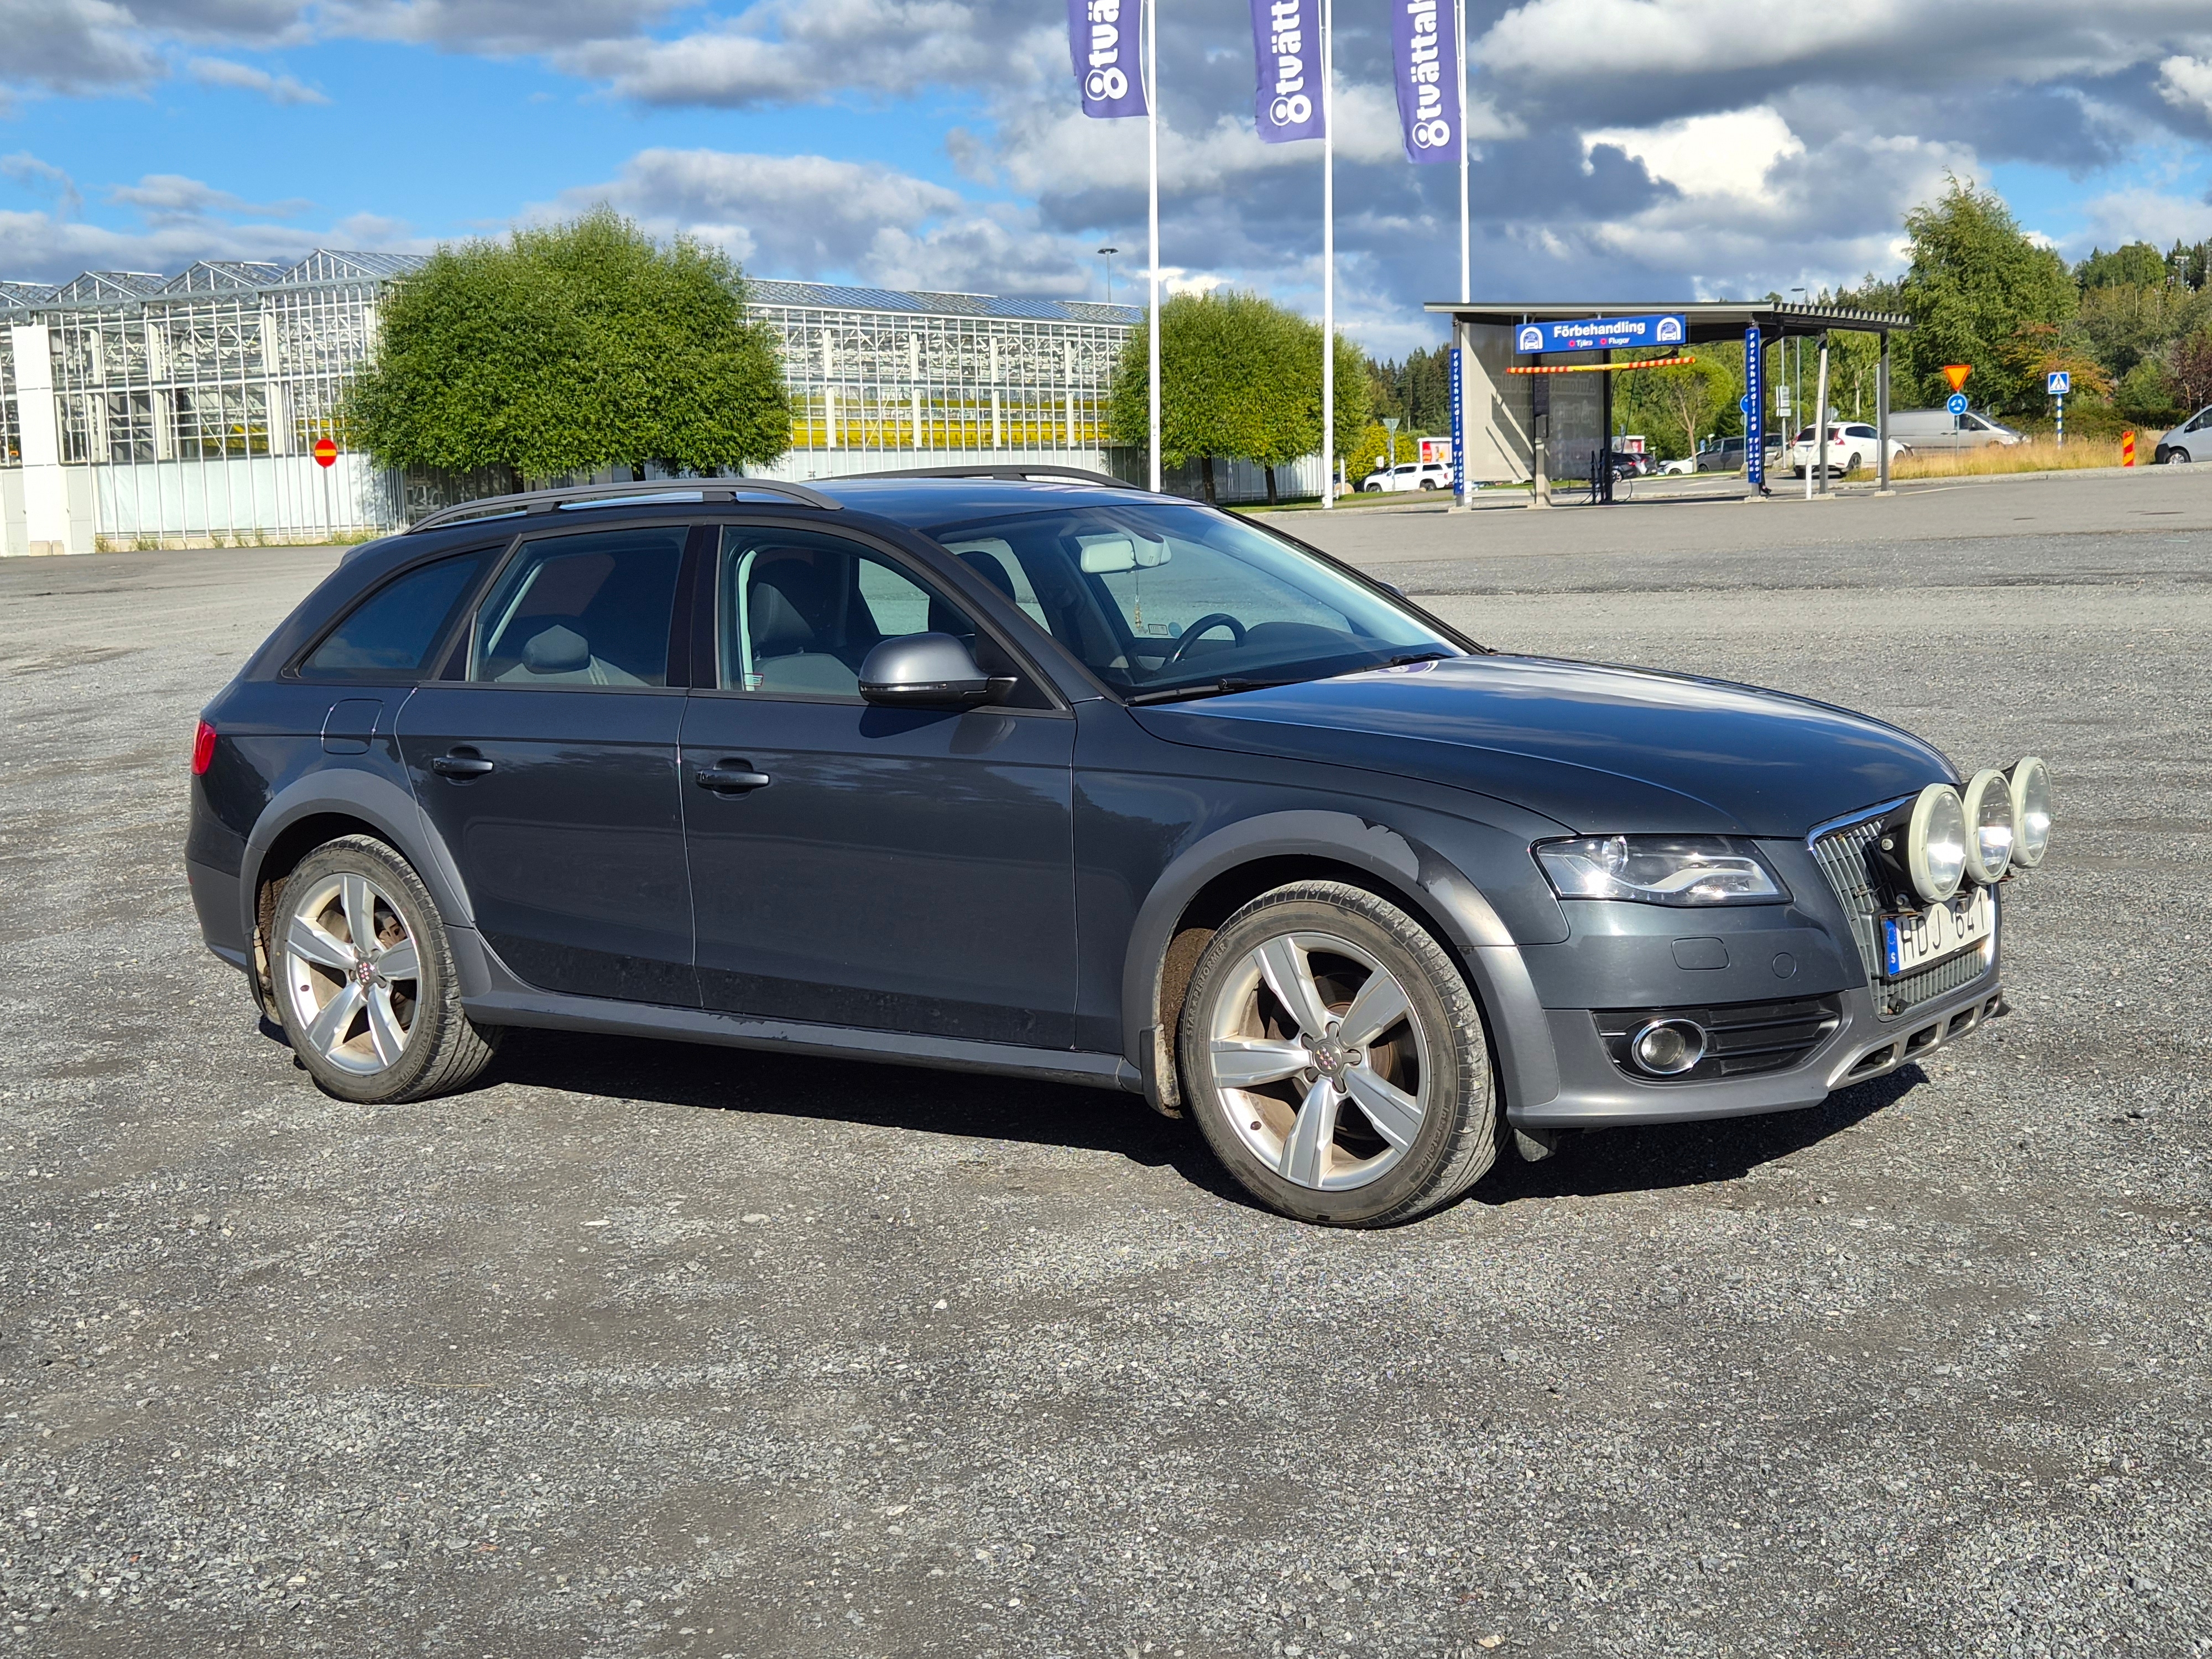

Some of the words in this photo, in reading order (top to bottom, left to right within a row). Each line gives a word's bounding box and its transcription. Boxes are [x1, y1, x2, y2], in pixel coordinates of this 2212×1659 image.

[1553, 321, 1646, 338] Förbehandling
[1608, 337, 1631, 345] Flugor
[1900, 910, 1942, 962] HDJ
[1955, 891, 1985, 940] 641
[1891, 952, 1896, 964] S
[1186, 1008, 1197, 1037] STAR
[1193, 942, 1227, 999] PERFORMER
[1418, 1106, 1449, 1171] Interstellar
[1252, 1183, 1274, 1201] OUTSIDE
